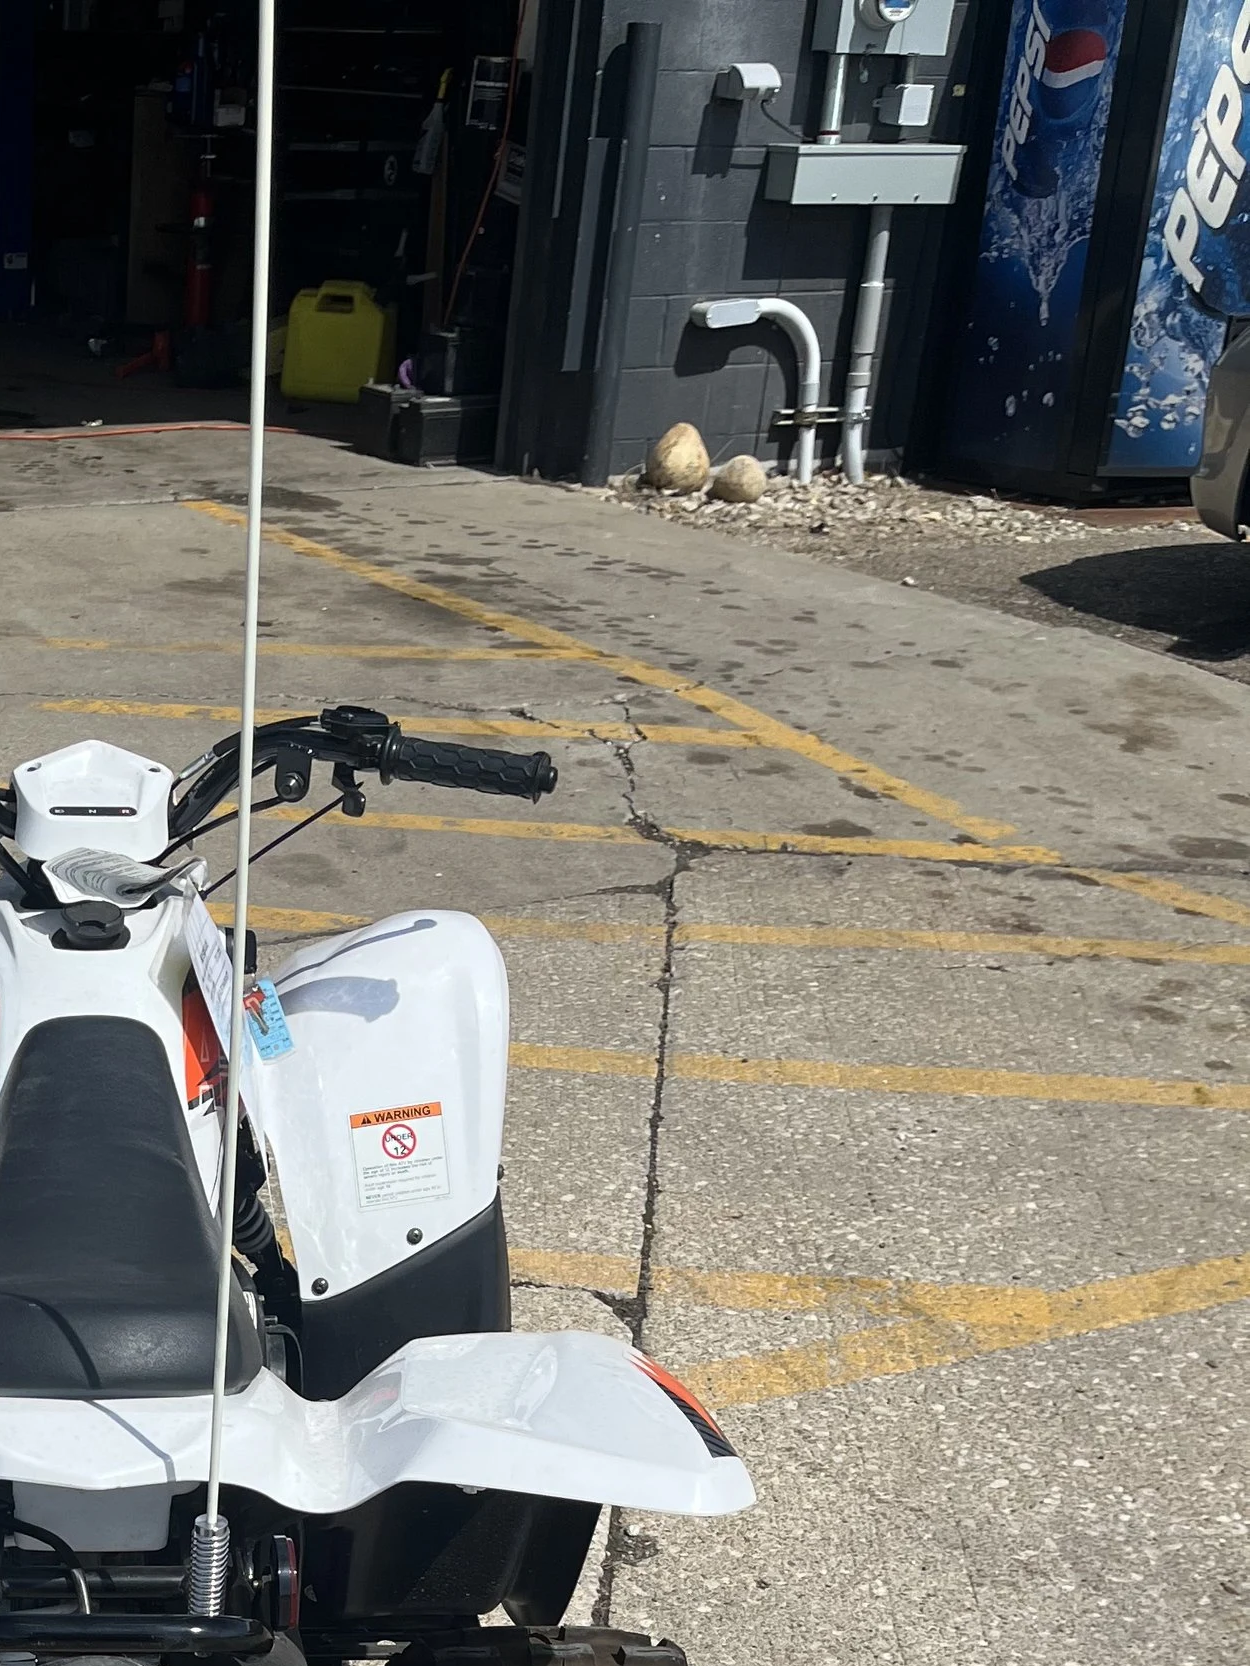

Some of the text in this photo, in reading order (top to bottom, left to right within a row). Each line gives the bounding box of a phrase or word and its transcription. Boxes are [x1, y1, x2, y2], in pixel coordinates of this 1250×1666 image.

[1002, 0, 1051, 181] PEPSI
[1164, 0, 1250, 293] PEP
[374, 1106, 431, 1123] WARNING
[393, 1145, 406, 1155] 12
